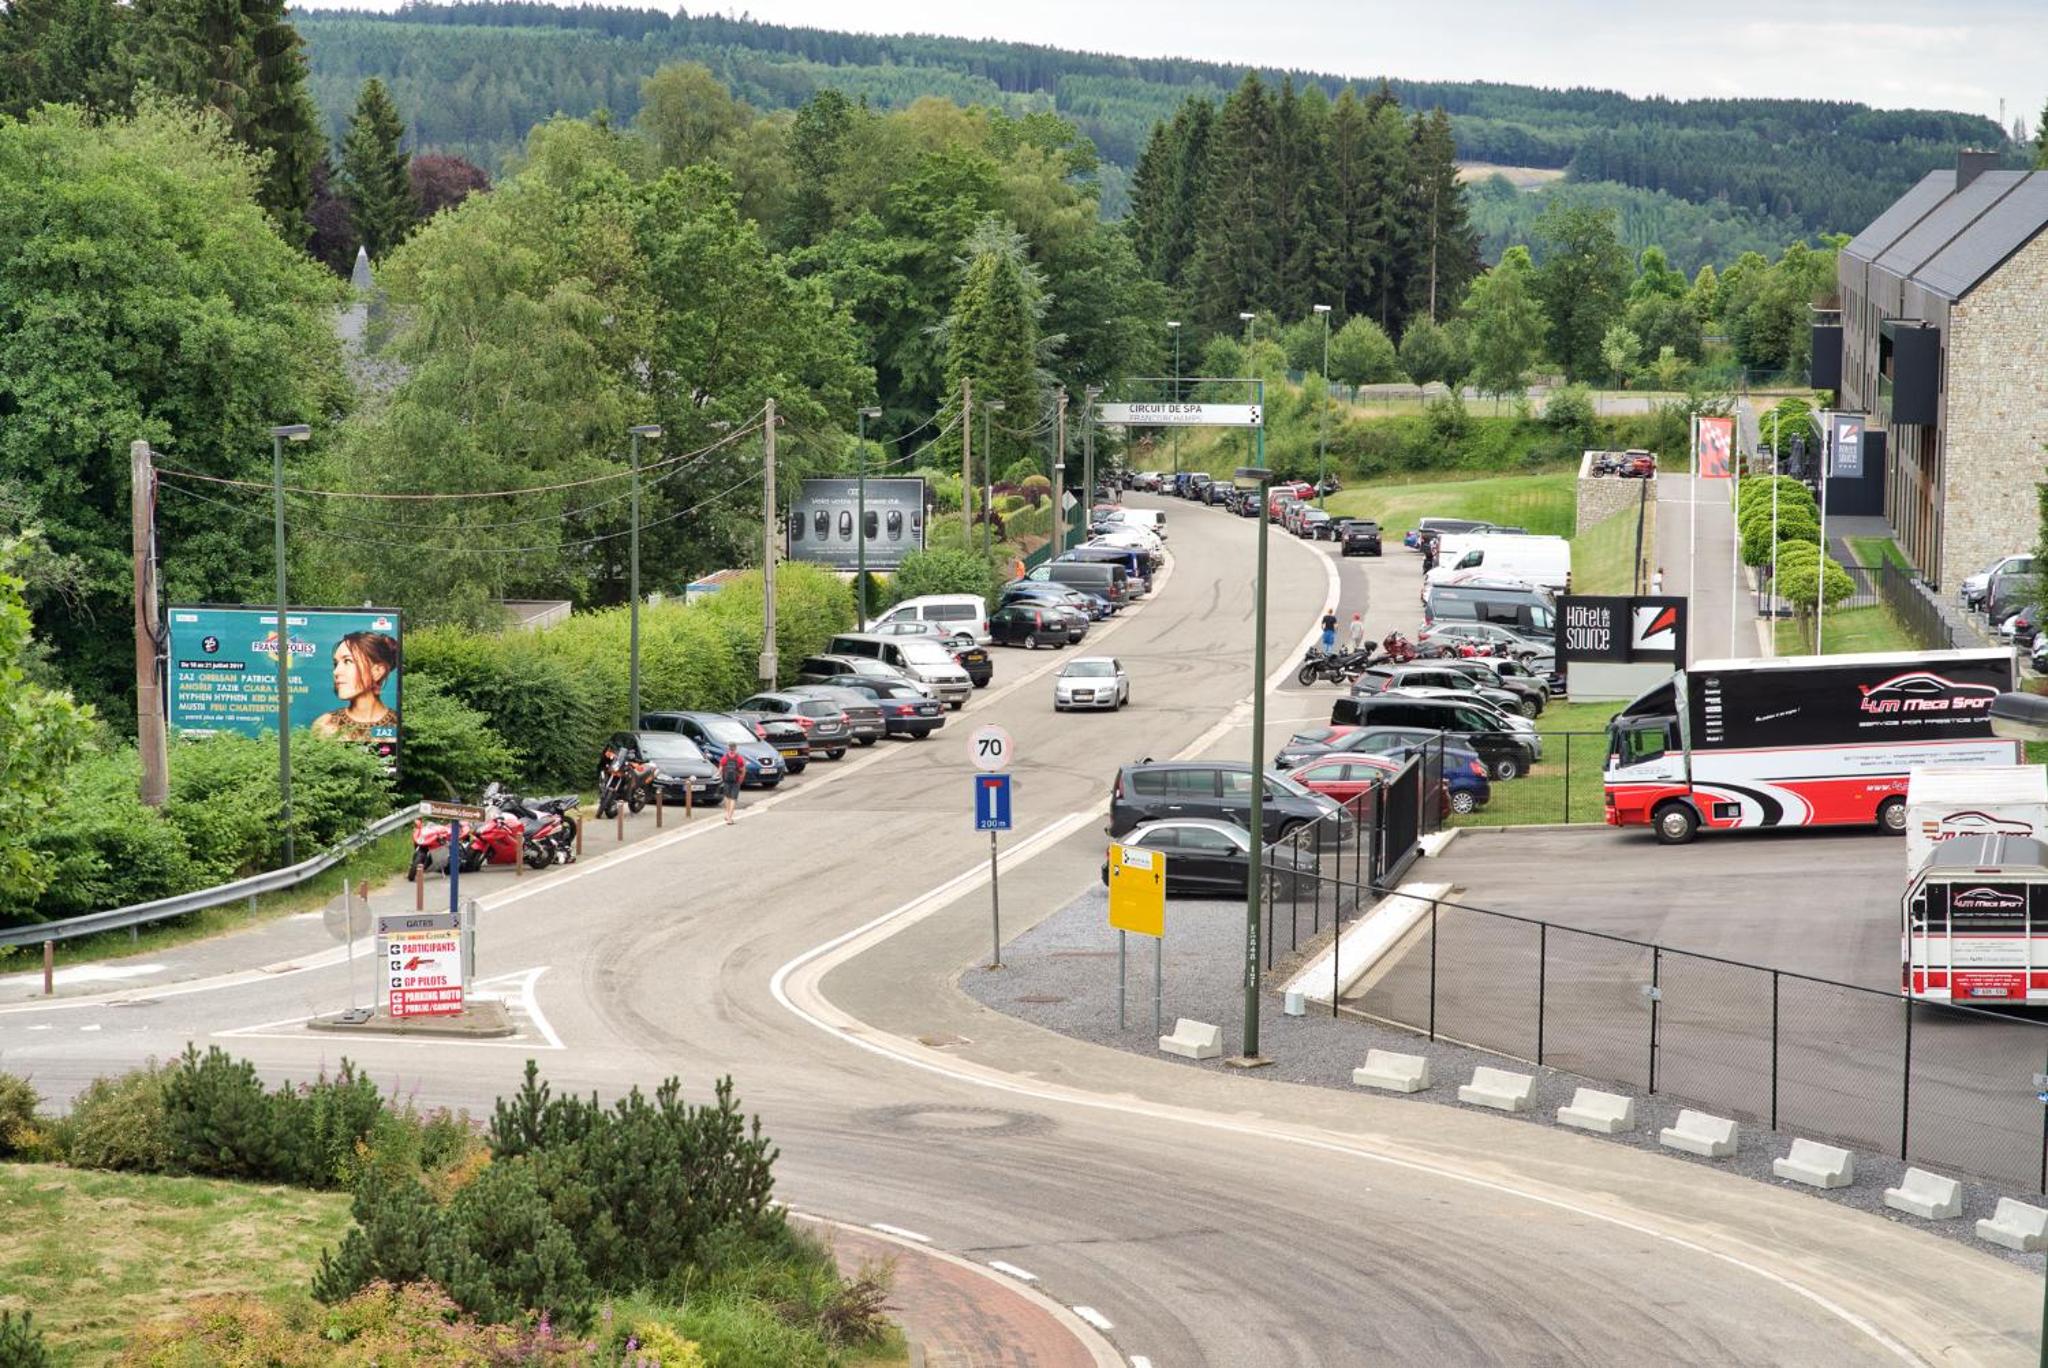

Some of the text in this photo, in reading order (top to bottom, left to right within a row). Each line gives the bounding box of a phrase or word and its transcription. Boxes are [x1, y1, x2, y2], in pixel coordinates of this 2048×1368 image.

[1129, 404, 1202, 413] CIRCUIT DE SPA
[253, 642, 313, 653] FRANCFOLIES
[179, 673, 195, 681] ZAZ
[241, 675, 277, 683] PATRICK
[179, 693, 212, 701] HYPHEN
[214, 693, 247, 702] HYPHEN
[376, 728, 393, 736] ZAZ
[978, 739, 1002, 757] 70
[981, 820, 998, 828] 200
[406, 920, 433, 928] GATES
[402, 942, 456, 954] PARTICIPANTS
[404, 975, 447, 987] GP PILOTS
[404, 989, 461, 1003] PARKING MOTO
